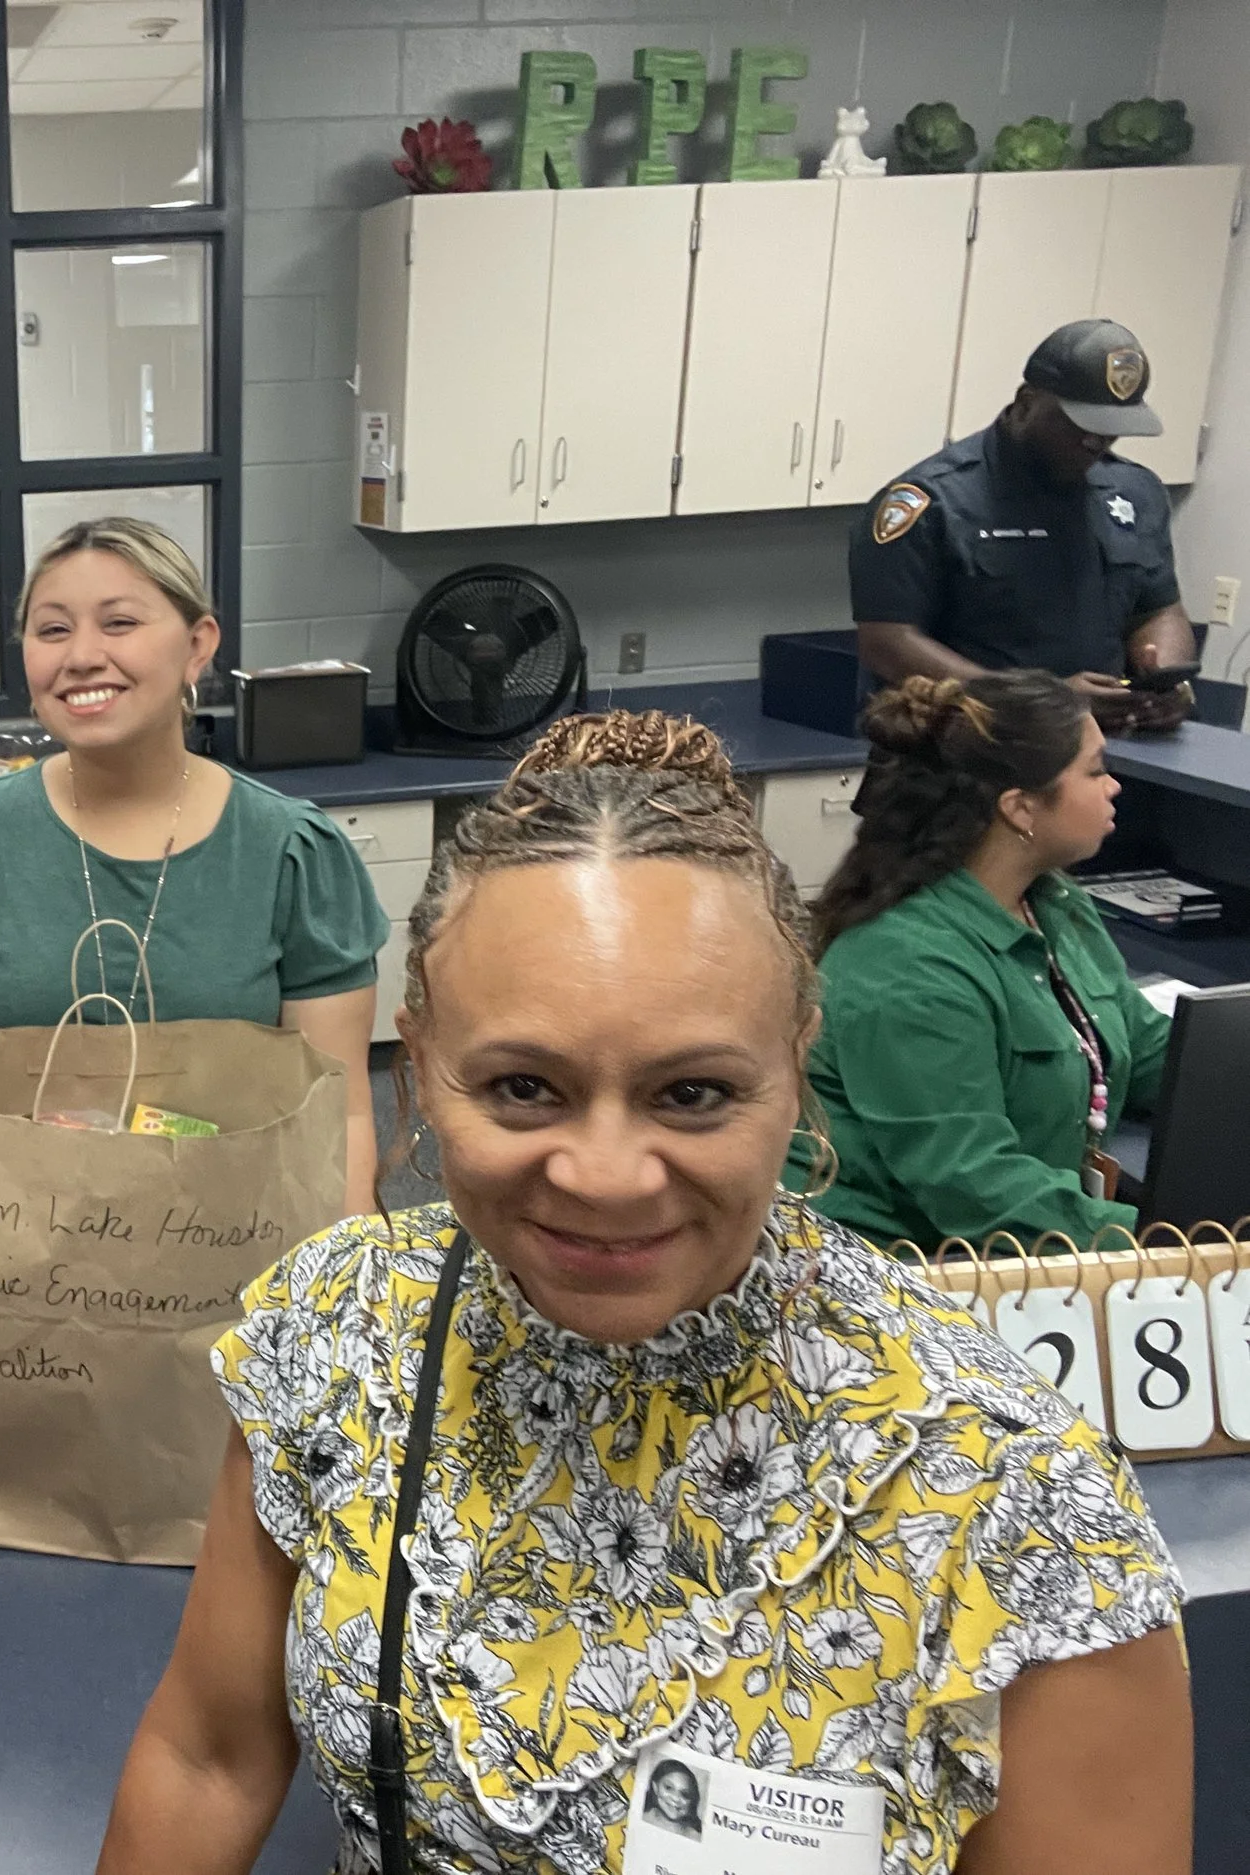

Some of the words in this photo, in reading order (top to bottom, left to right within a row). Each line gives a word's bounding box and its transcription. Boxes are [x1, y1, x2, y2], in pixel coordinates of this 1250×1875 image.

[519, 47, 808, 190] RPE
[50, 1195, 133, 1243] Lake
[156, 1206, 283, 1248] Houston
[749, 1782, 846, 1819] VISITOR
[712, 1811, 756, 1839] Mary
[760, 1825, 821, 1849] Cureau
